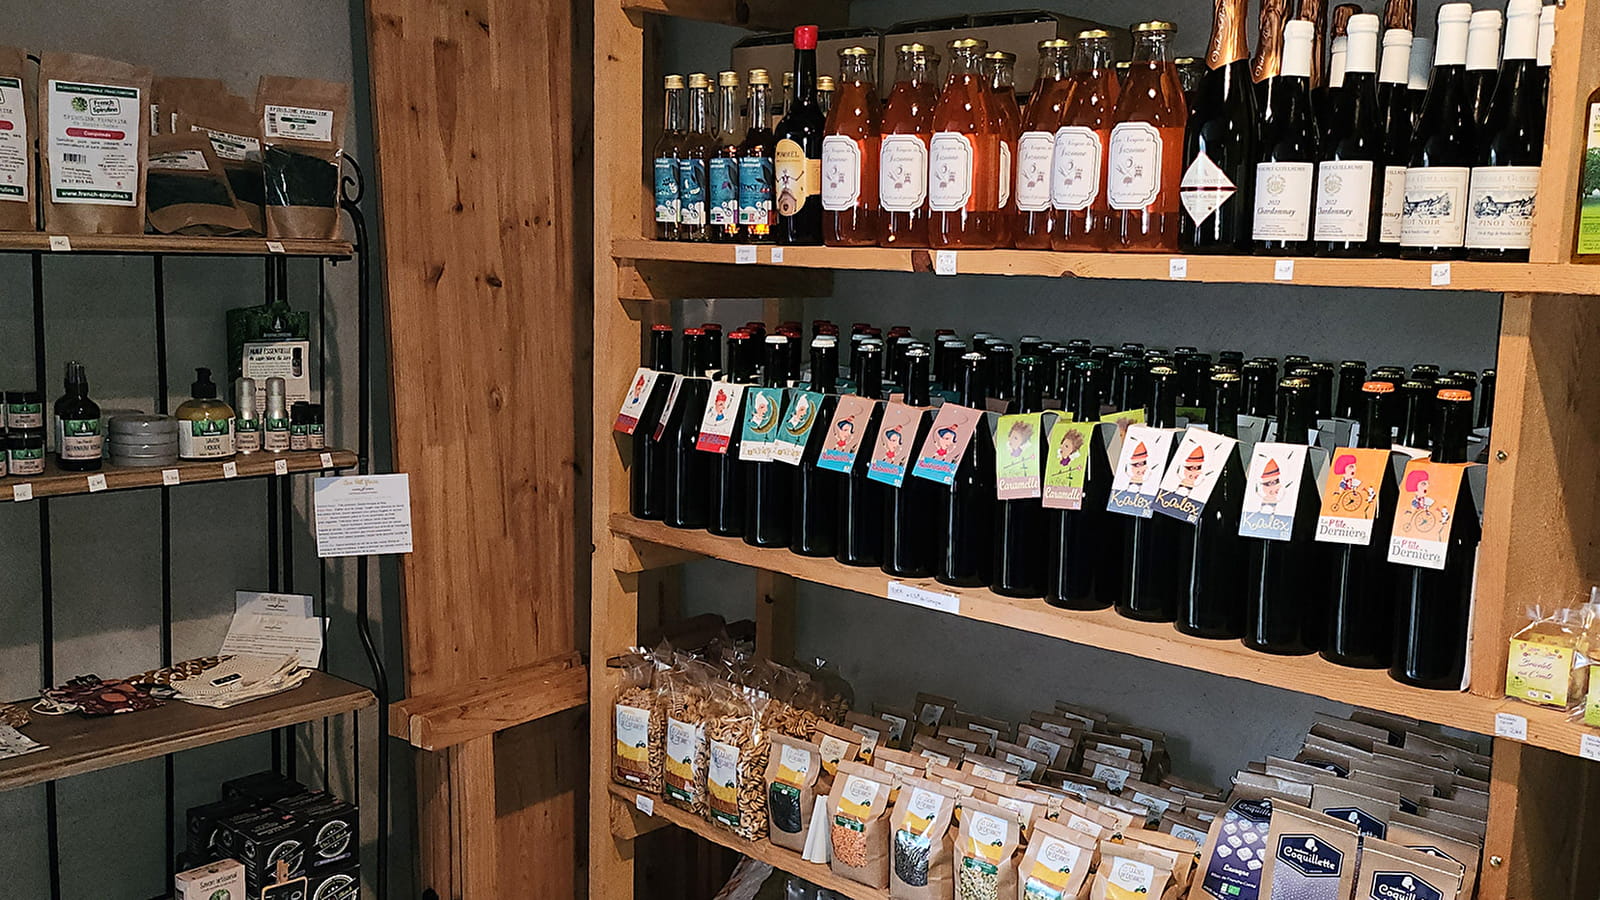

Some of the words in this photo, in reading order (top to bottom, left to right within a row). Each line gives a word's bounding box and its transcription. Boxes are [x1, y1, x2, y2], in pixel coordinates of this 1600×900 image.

[1257, 206, 1296, 216] Chardonnay
[1110, 490, 1153, 509] Kalex
[1156, 490, 1200, 516] Kalex
[1243, 512, 1290, 532] Kalex
[1319, 525, 1368, 539] Dernière
[1392, 545, 1441, 562] Dernière
[1282, 846, 1336, 871] Coquillette
[200, 880, 215, 889] Savon
